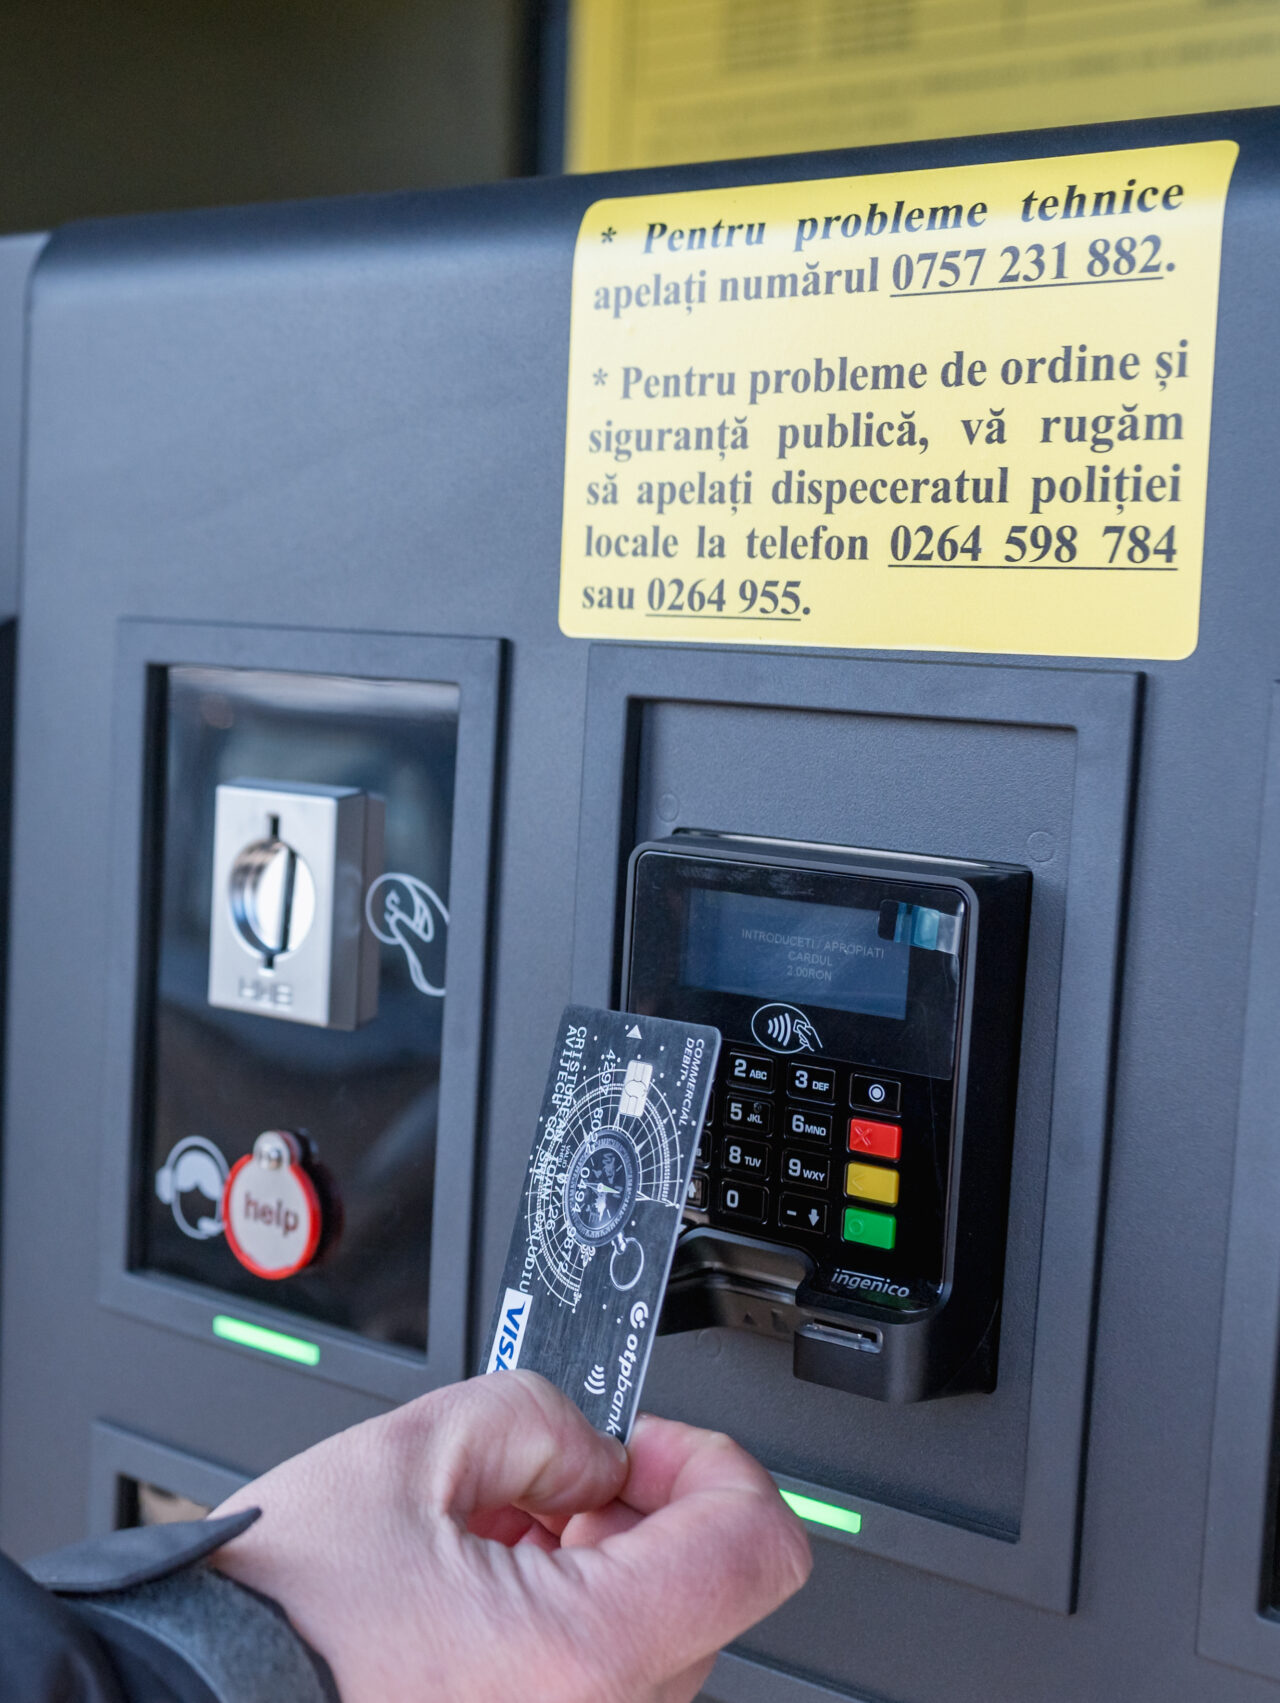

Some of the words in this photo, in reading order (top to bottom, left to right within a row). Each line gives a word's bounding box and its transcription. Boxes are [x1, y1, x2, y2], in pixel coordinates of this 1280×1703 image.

[643, 214, 766, 255] Pentru
[793, 194, 988, 252] probleme
[1020, 178, 1185, 224] tehnice
[593, 269, 708, 317] apelați
[719, 257, 880, 303] numărul
[891, 250, 982, 292] 0757
[998, 242, 1068, 285] 231
[1087, 234, 1177, 277] 882.
[620, 359, 736, 400] Pentru
[749, 352, 928, 406] probleme
[940, 350, 989, 390] de
[1000, 344, 1141, 386] ordine
[1155, 339, 1190, 392] și
[588, 416, 750, 462] siguranță
[776, 410, 929, 459] publică,
[962, 408, 1007, 445] vă
[1039, 404, 1183, 455] rugăm
[586, 474, 619, 506] să
[636, 470, 753, 517] apelați
[771, 466, 1009, 512] dispeceratul
[1030, 463, 1182, 516] poliției
[584, 525, 679, 559] locale
[696, 525, 726, 559] la
[745, 525, 870, 561] telefon
[889, 525, 983, 563] 0264
[1004, 524, 1078, 563] 598
[1101, 525, 1178, 564] 784
[582, 583, 635, 611] sau
[647, 578, 726, 614] 0264
[739, 578, 812, 617] 955.
[742, 929, 815, 948] INTRODUCETI
[824, 941, 884, 959] APROPIATI
[788, 952, 833, 966] CARDUL
[787, 966, 832, 981] 2.00RON
[679, 1037, 695, 1079] DEBIT
[734, 1059, 746, 1077] 2
[749, 1069, 767, 1081] ABC
[678, 1038, 705, 1126] COMMERCIAL
[795, 1070, 808, 1088] 3
[812, 1081, 829, 1091] DEF
[730, 1103, 742, 1121] 5
[747, 1112, 763, 1124] JKL
[791, 1115, 804, 1133] 6
[805, 1125, 826, 1136] MNO
[729, 1146, 741, 1164] 8
[744, 1155, 761, 1168] TUV
[788, 1159, 801, 1177] 9
[803, 1169, 825, 1182] WXY
[244, 1192, 299, 1236] help
[726, 1190, 739, 1209] 0
[832, 1268, 910, 1297] ingenico
[606, 1333, 638, 1437] otpbank
